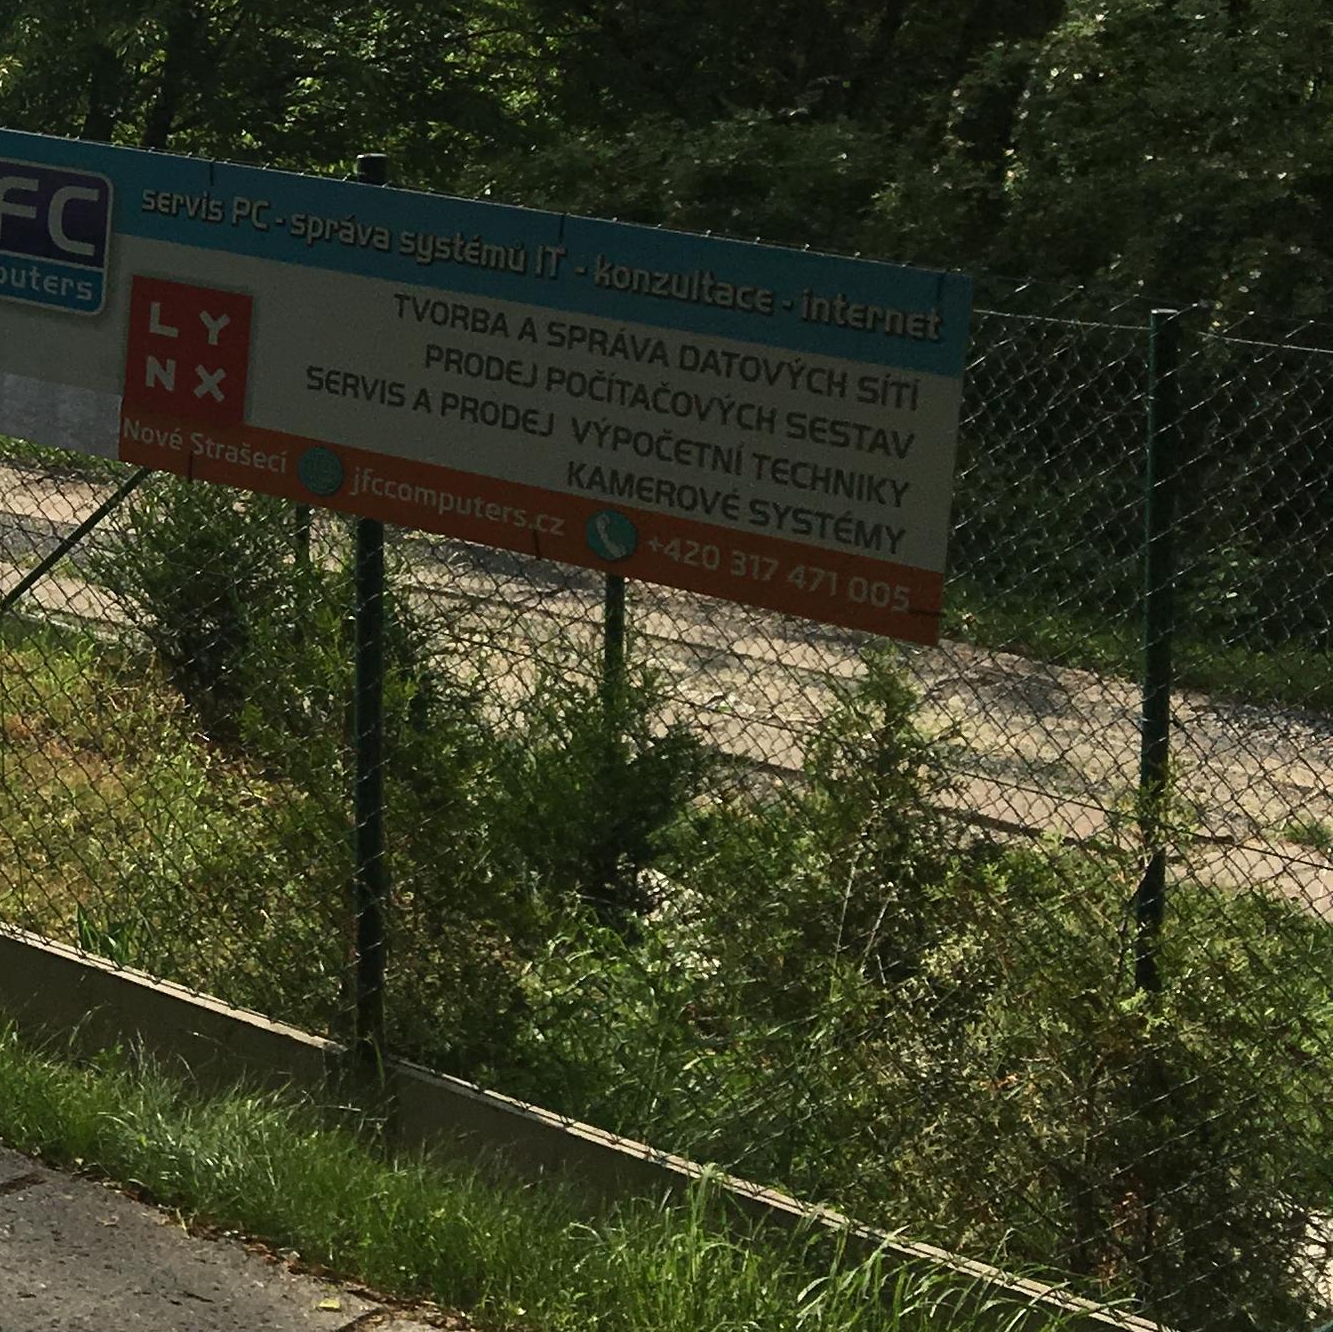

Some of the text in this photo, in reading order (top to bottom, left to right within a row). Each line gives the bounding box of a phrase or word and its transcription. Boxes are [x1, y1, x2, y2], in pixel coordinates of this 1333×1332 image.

[141, 187, 225, 223] servis
[232, 195, 271, 231] PC
[290, 215, 391, 251] správa
[399, 230, 528, 274] systémů
[535, 243, 566, 279] IT
[593, 253, 775, 316] konzultace
[801, 287, 944, 342] internet
[394, 293, 921, 411] TVORBA A SPRÁVA DATOVÝCH SÍTÍ
[425, 343, 916, 459] PRODEJ POČÍTAČOVÝCH SESTAV
[121, 416, 288, 474] Nové Strašecí
[306, 365, 911, 508] SERVIS A PRODEJ VÝPOČETNÍ TECHNIKY
[348, 466, 565, 537] jfccomputers.cz
[566, 459, 908, 555] KAMEROVÉ SYSTÉMY
[646, 535, 911, 614] +420 317 471 005
